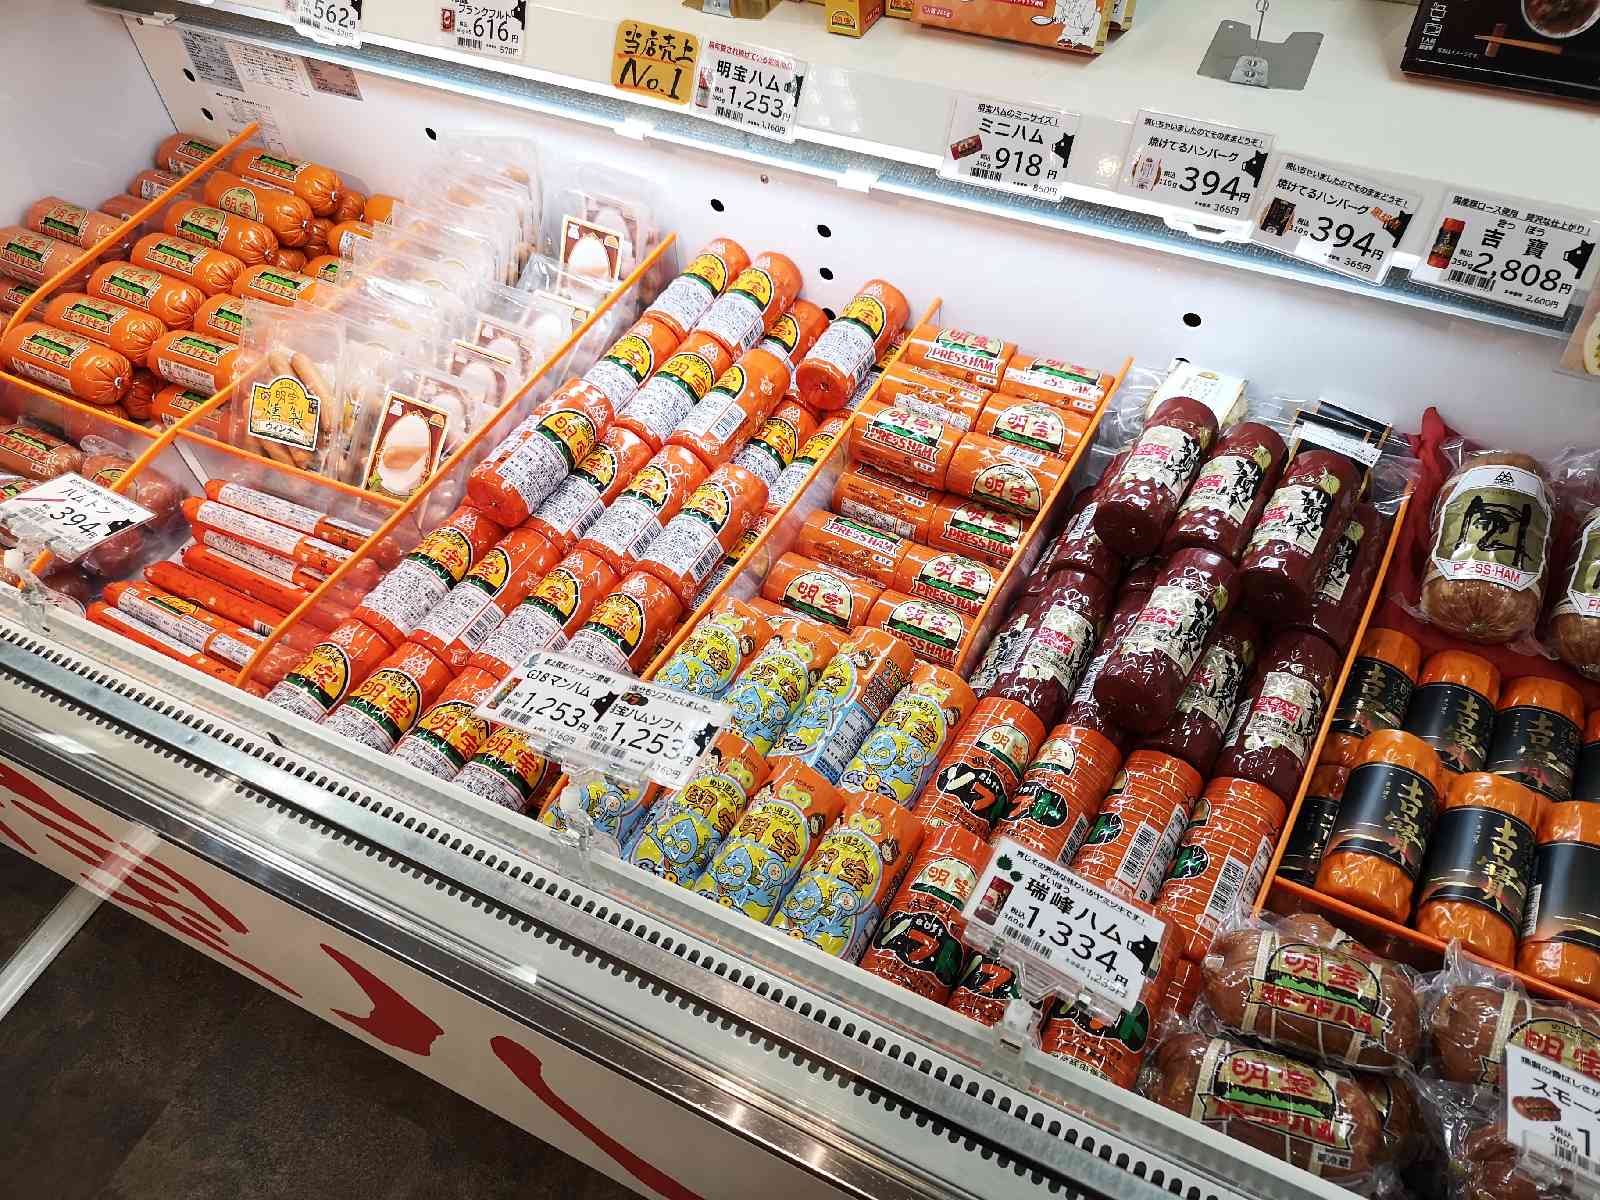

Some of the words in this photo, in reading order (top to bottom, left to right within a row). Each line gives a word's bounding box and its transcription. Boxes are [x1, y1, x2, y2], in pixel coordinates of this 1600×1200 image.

[473, 17, 519, 44] 616円
[624, 24, 694, 63] 当店売上
[619, 58, 682, 100] No.1
[716, 59, 780, 93] 明宝ハム
[978, 117, 1044, 145] ミニハム
[1148, 136, 1239, 162] 焼けてるハンバーグ
[1179, 166, 1251, 203] 394円
[1277, 178, 1370, 215] 焼けてるハンバーグ
[1214, 203, 1240, 216] 365円
[1310, 216, 1384, 261] 394円
[1344, 257, 1371, 273] 365円
[1473, 253, 1572, 295] 2,808円
[1526, 294, 1559, 309] 2,600円
[931, 347, 968, 368] PRESS
[968, 356, 995, 373] HAM
[265, 421, 300, 437] ウィンナー
[1008, 413, 1057, 440] 明宝
[984, 476, 1031, 506] 明宝
[797, 582, 844, 613] 明宝
[362, 678, 411, 720] 明宝
[522, 691, 589, 733] 1,253円
[486, 734, 541, 779] 明宝
[1025, 876, 1122, 946] 瑞峰ハム
[1026, 905, 1129, 987] 1,334円
[1284, 951, 1365, 994] 明宝
[1231, 1057, 1317, 1096] 明宝
